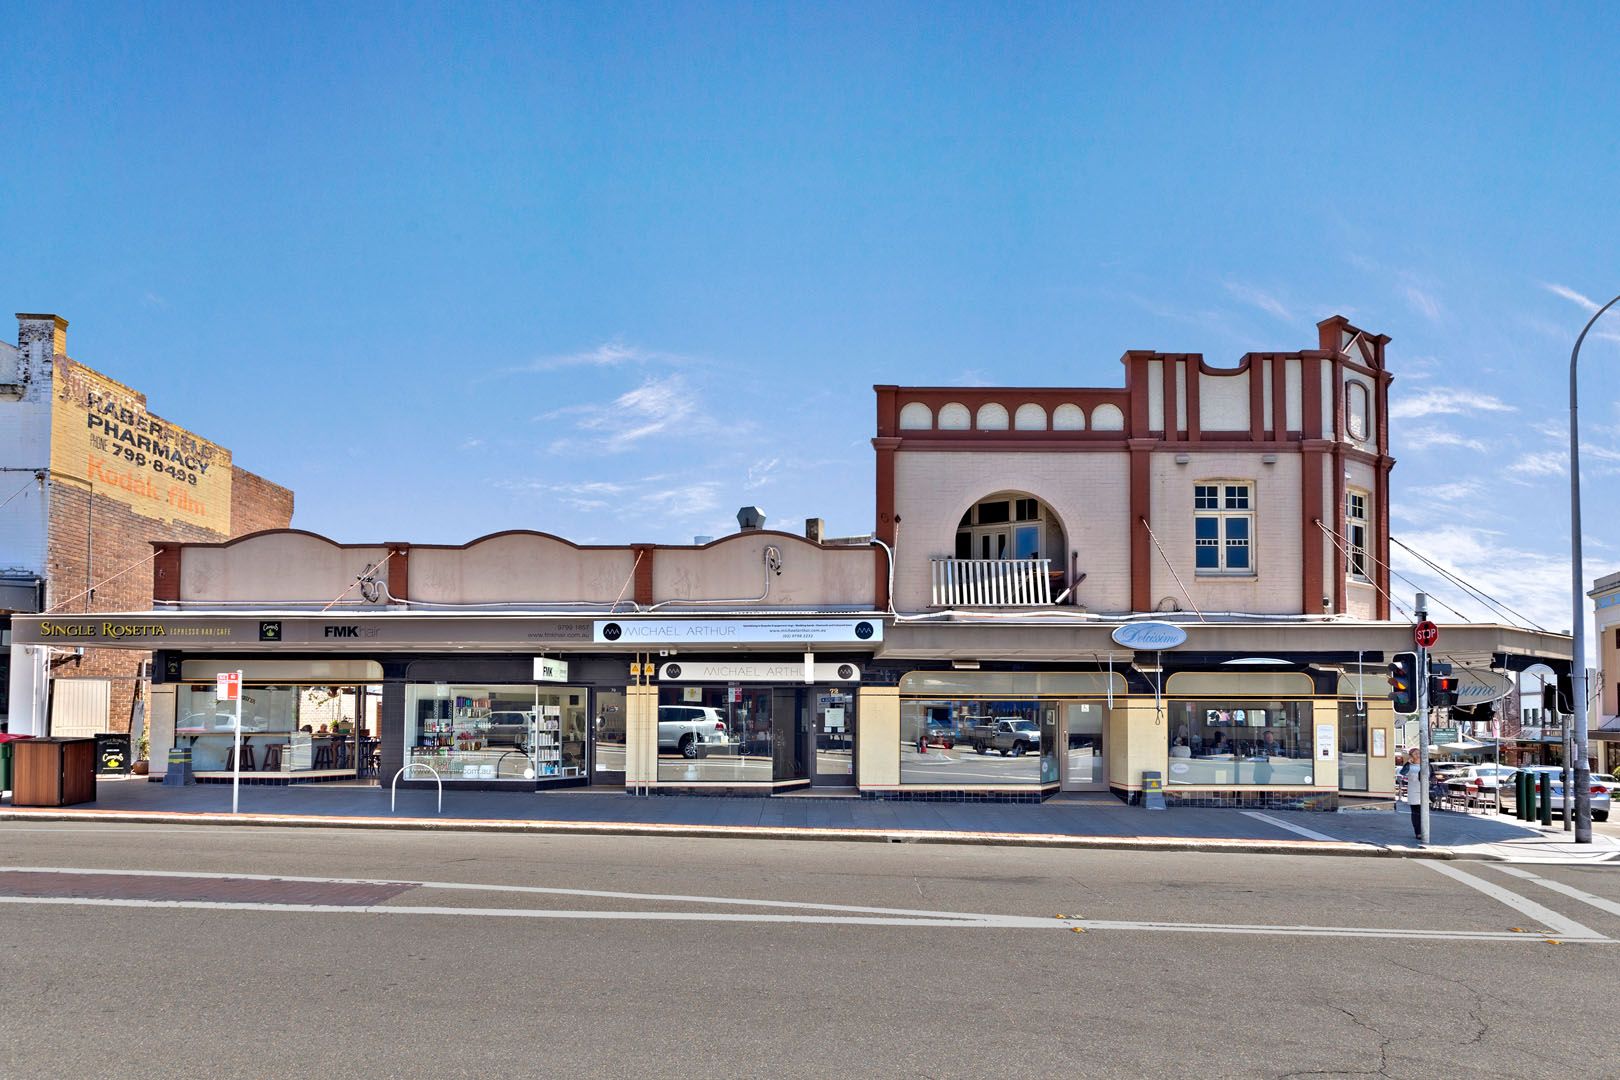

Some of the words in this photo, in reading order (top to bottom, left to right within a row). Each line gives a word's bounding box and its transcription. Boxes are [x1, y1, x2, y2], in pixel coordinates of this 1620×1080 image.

[87, 413, 209, 475] PHARMACY
[90, 433, 108, 452] PHONE
[624, 626, 681, 637] MICHAEL
[686, 626, 737, 637] ARTHUR
[1417, 629, 1436, 640] STOP
[703, 666, 760, 676] MICHAEL
[766, 666, 815, 676] ARTHU
